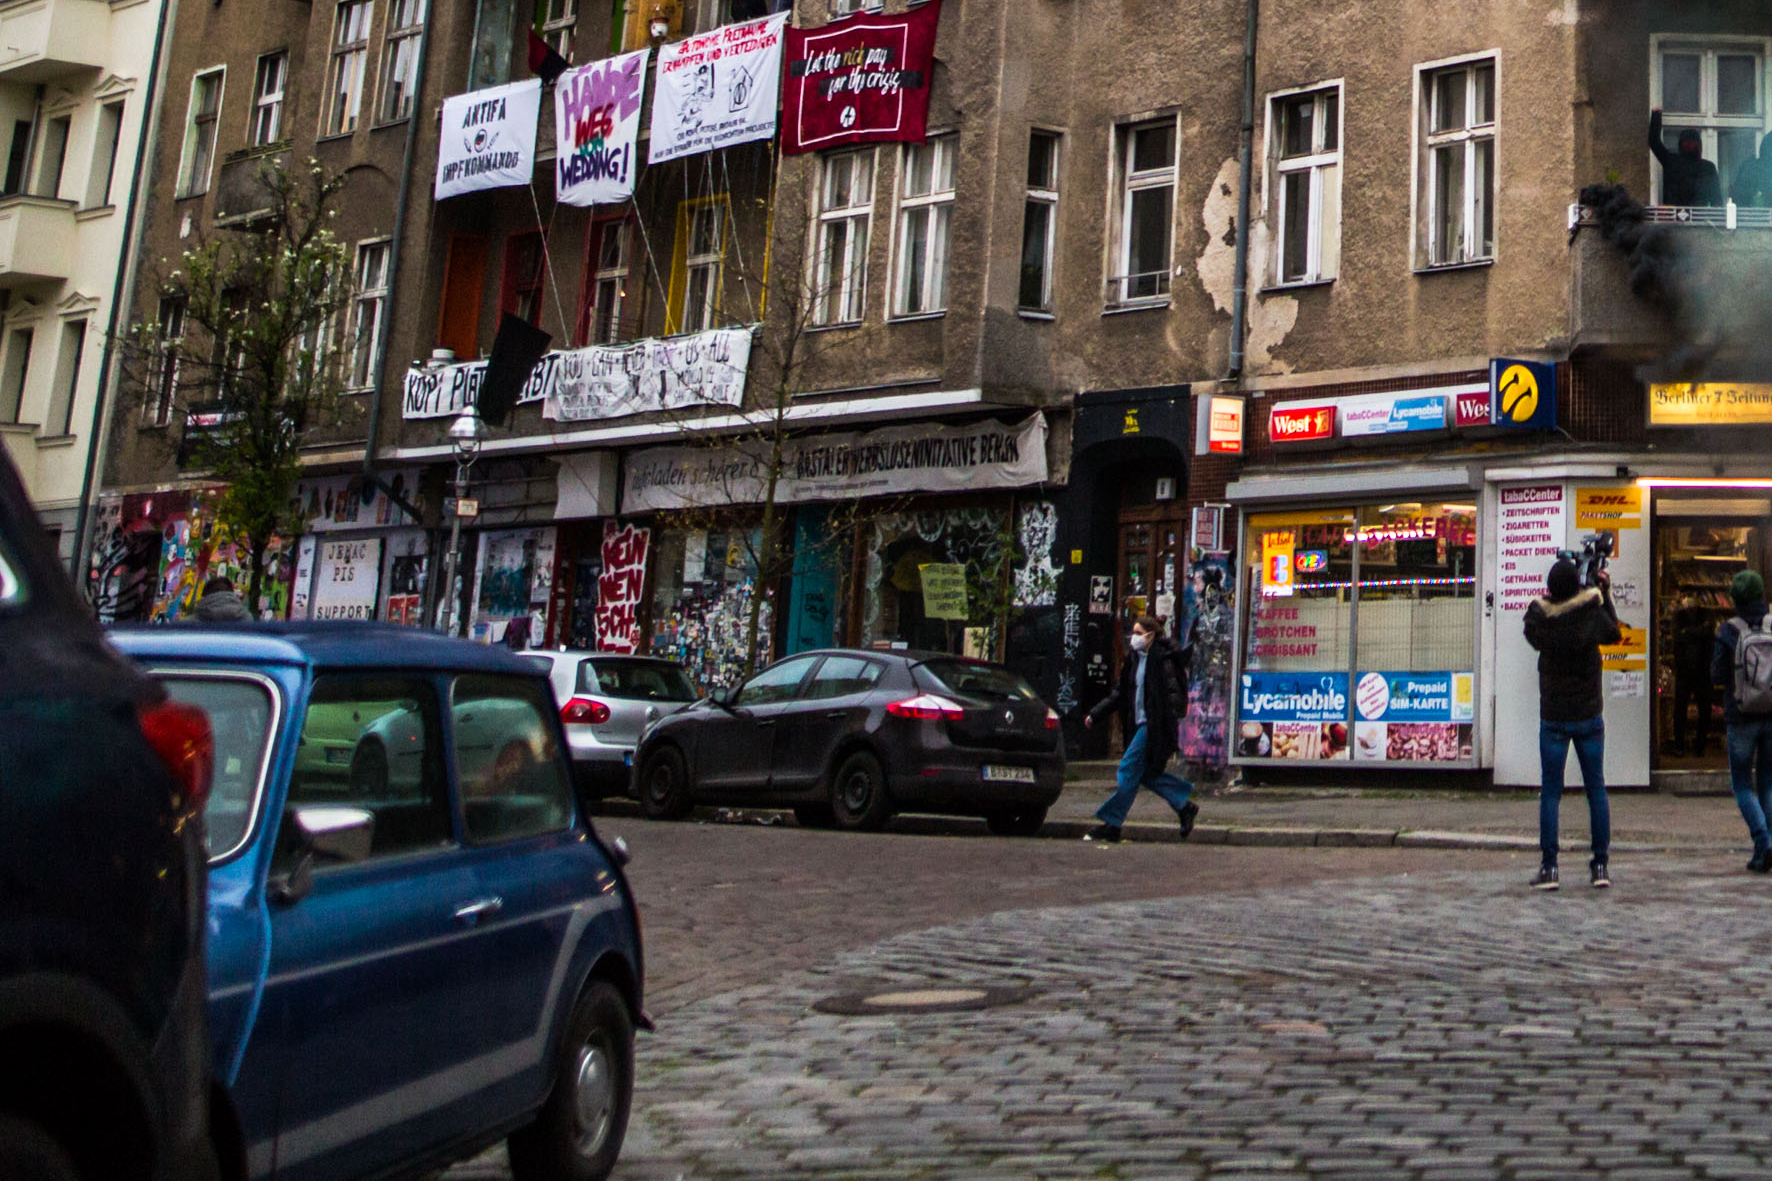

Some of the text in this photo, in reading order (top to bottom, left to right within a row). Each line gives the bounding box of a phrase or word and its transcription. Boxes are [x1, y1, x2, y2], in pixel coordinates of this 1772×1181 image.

[805, 41, 888, 76] Let the rich pay
[827, 76, 847, 101] for
[867, 67, 900, 95] crisis
[562, 53, 641, 140] HÄNDE
[575, 103, 615, 148] WEG
[560, 141, 630, 190] WEDDING!
[1655, 389, 1711, 406] Berliner
[1393, 403, 1443, 419] Lycamobile
[1459, 399, 1489, 419] Wes
[1274, 416, 1311, 435] West
[1504, 490, 1560, 502] tabaCCenter
[1589, 496, 1628, 505] DHL
[1506, 507, 1560, 517] ZEITSCHRIFTEN
[1506, 521, 1549, 531] ZIGARETTEN
[1505, 549, 1533, 557] PACKET
[1505, 562, 1516, 570] EIS
[333, 567, 355, 582] PIS
[1505, 574, 1542, 583] GETRÄNKE
[1504, 587, 1551, 598] SPIRITUOSE
[316, 605, 371, 619] SUPPORT
[1257, 608, 1299, 620] KAFFEE
[1257, 625, 1316, 638] BRÖTCHEN
[1256, 643, 1317, 657] CROISSANT
[1407, 681, 1447, 695] Prepaid
[1243, 687, 1345, 715] Lycamobile
[1389, 697, 1449, 710] SIM-KARTE
[1296, 711, 1322, 721] Prepaid
